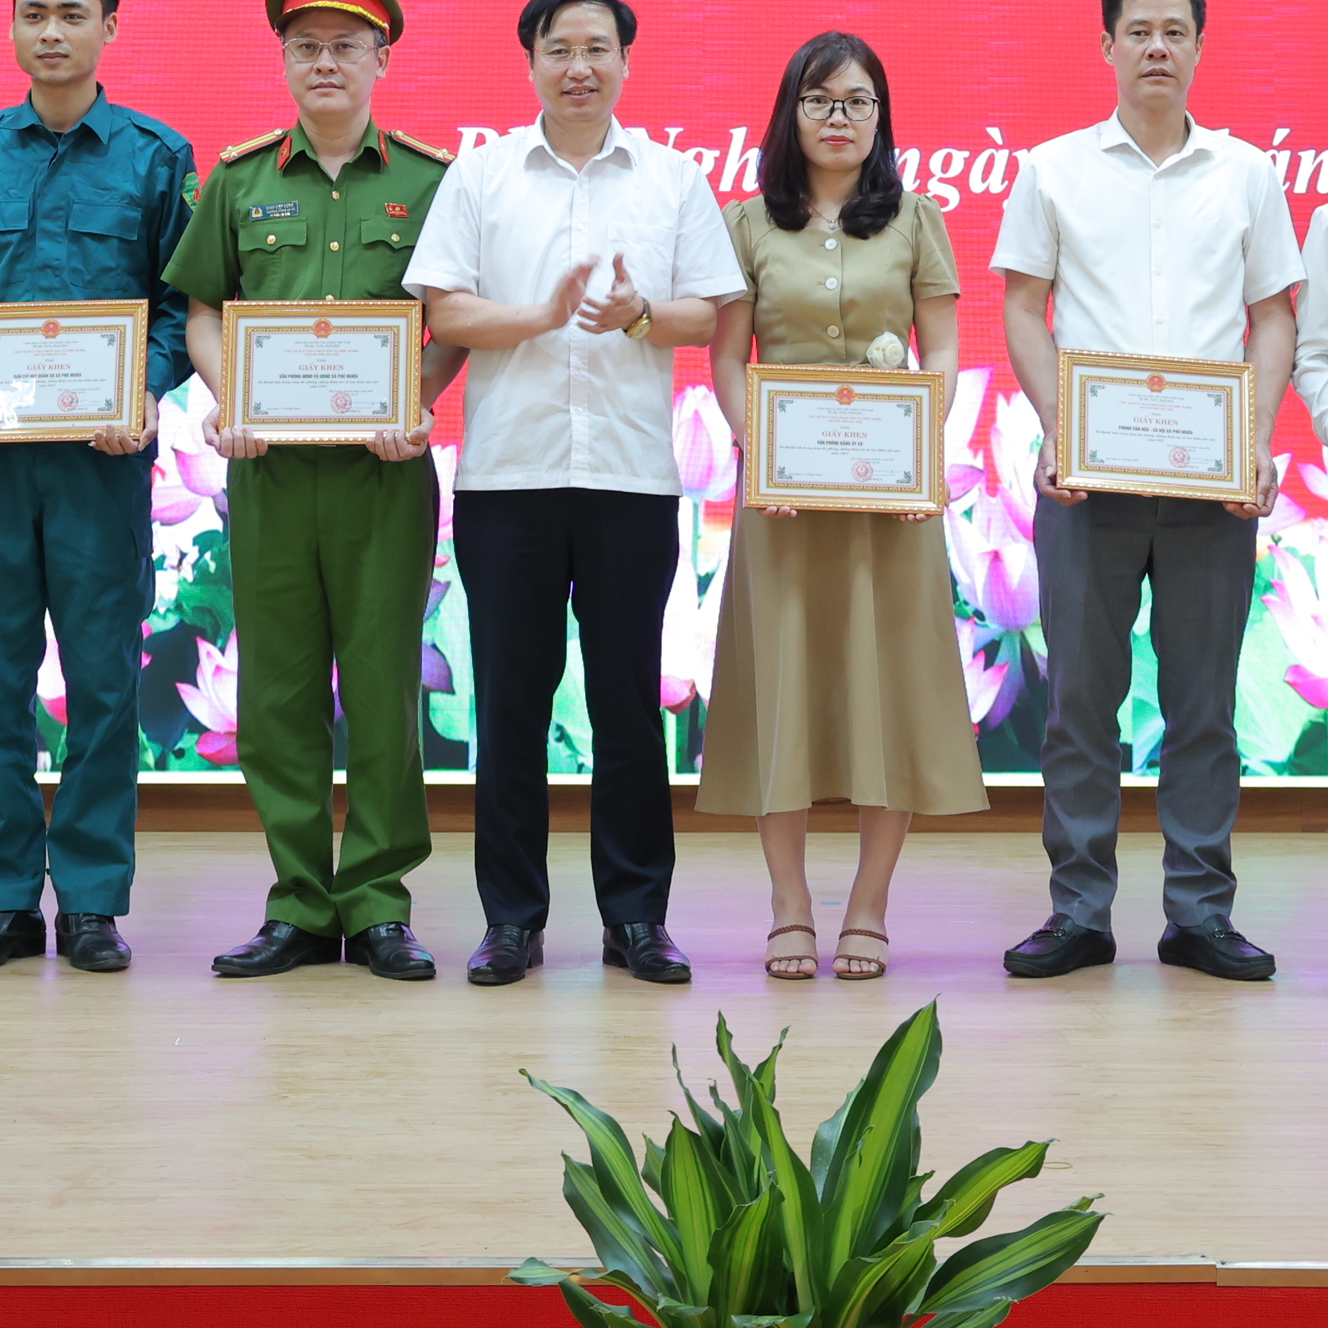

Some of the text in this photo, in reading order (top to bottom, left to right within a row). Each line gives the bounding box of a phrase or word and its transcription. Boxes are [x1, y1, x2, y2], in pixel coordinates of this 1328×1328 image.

[27, 362, 47, 371] GIẤY
[298, 362, 319, 371] GIẤY
[1133, 416, 1179, 426] GIẤY KHEN
[822, 429, 842, 437] GIẤY
